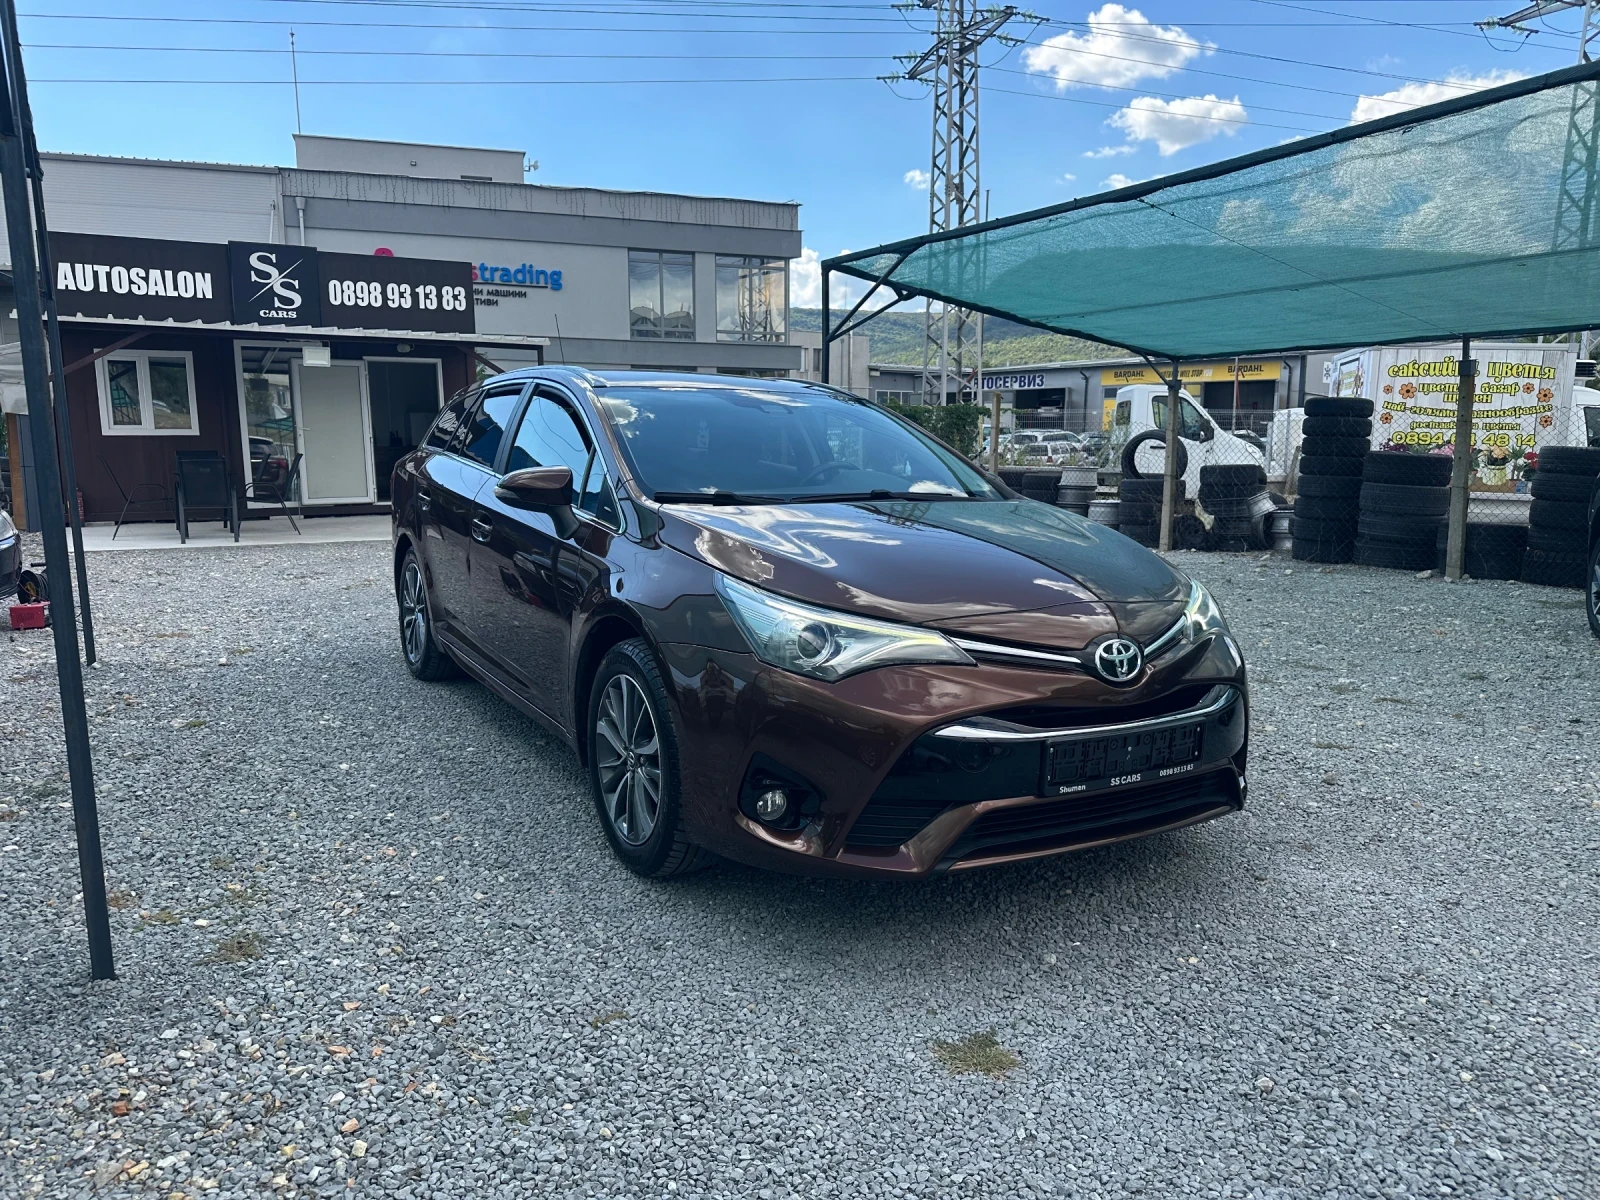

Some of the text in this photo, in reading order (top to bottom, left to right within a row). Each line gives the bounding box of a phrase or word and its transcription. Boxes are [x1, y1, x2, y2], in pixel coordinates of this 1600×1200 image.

[57, 262, 213, 299] AUTOSALON
[328, 279, 467, 311] 0898 93 13 83
[486, 288, 527, 299] машини
[259, 309, 297, 319] CARS
[1113, 370, 1145, 383] BARDAHL
[1227, 364, 1265, 379] BARDAHL
[1481, 381, 1520, 396] базар
[1471, 403, 1553, 419] азнообразие
[1391, 430, 1445, 445] 0894
[1482, 432, 1510, 447] 48
[1515, 433, 1537, 447] 14
[1110, 773, 1141, 786] SS CARS
[1059, 784, 1086, 794] Shumen
